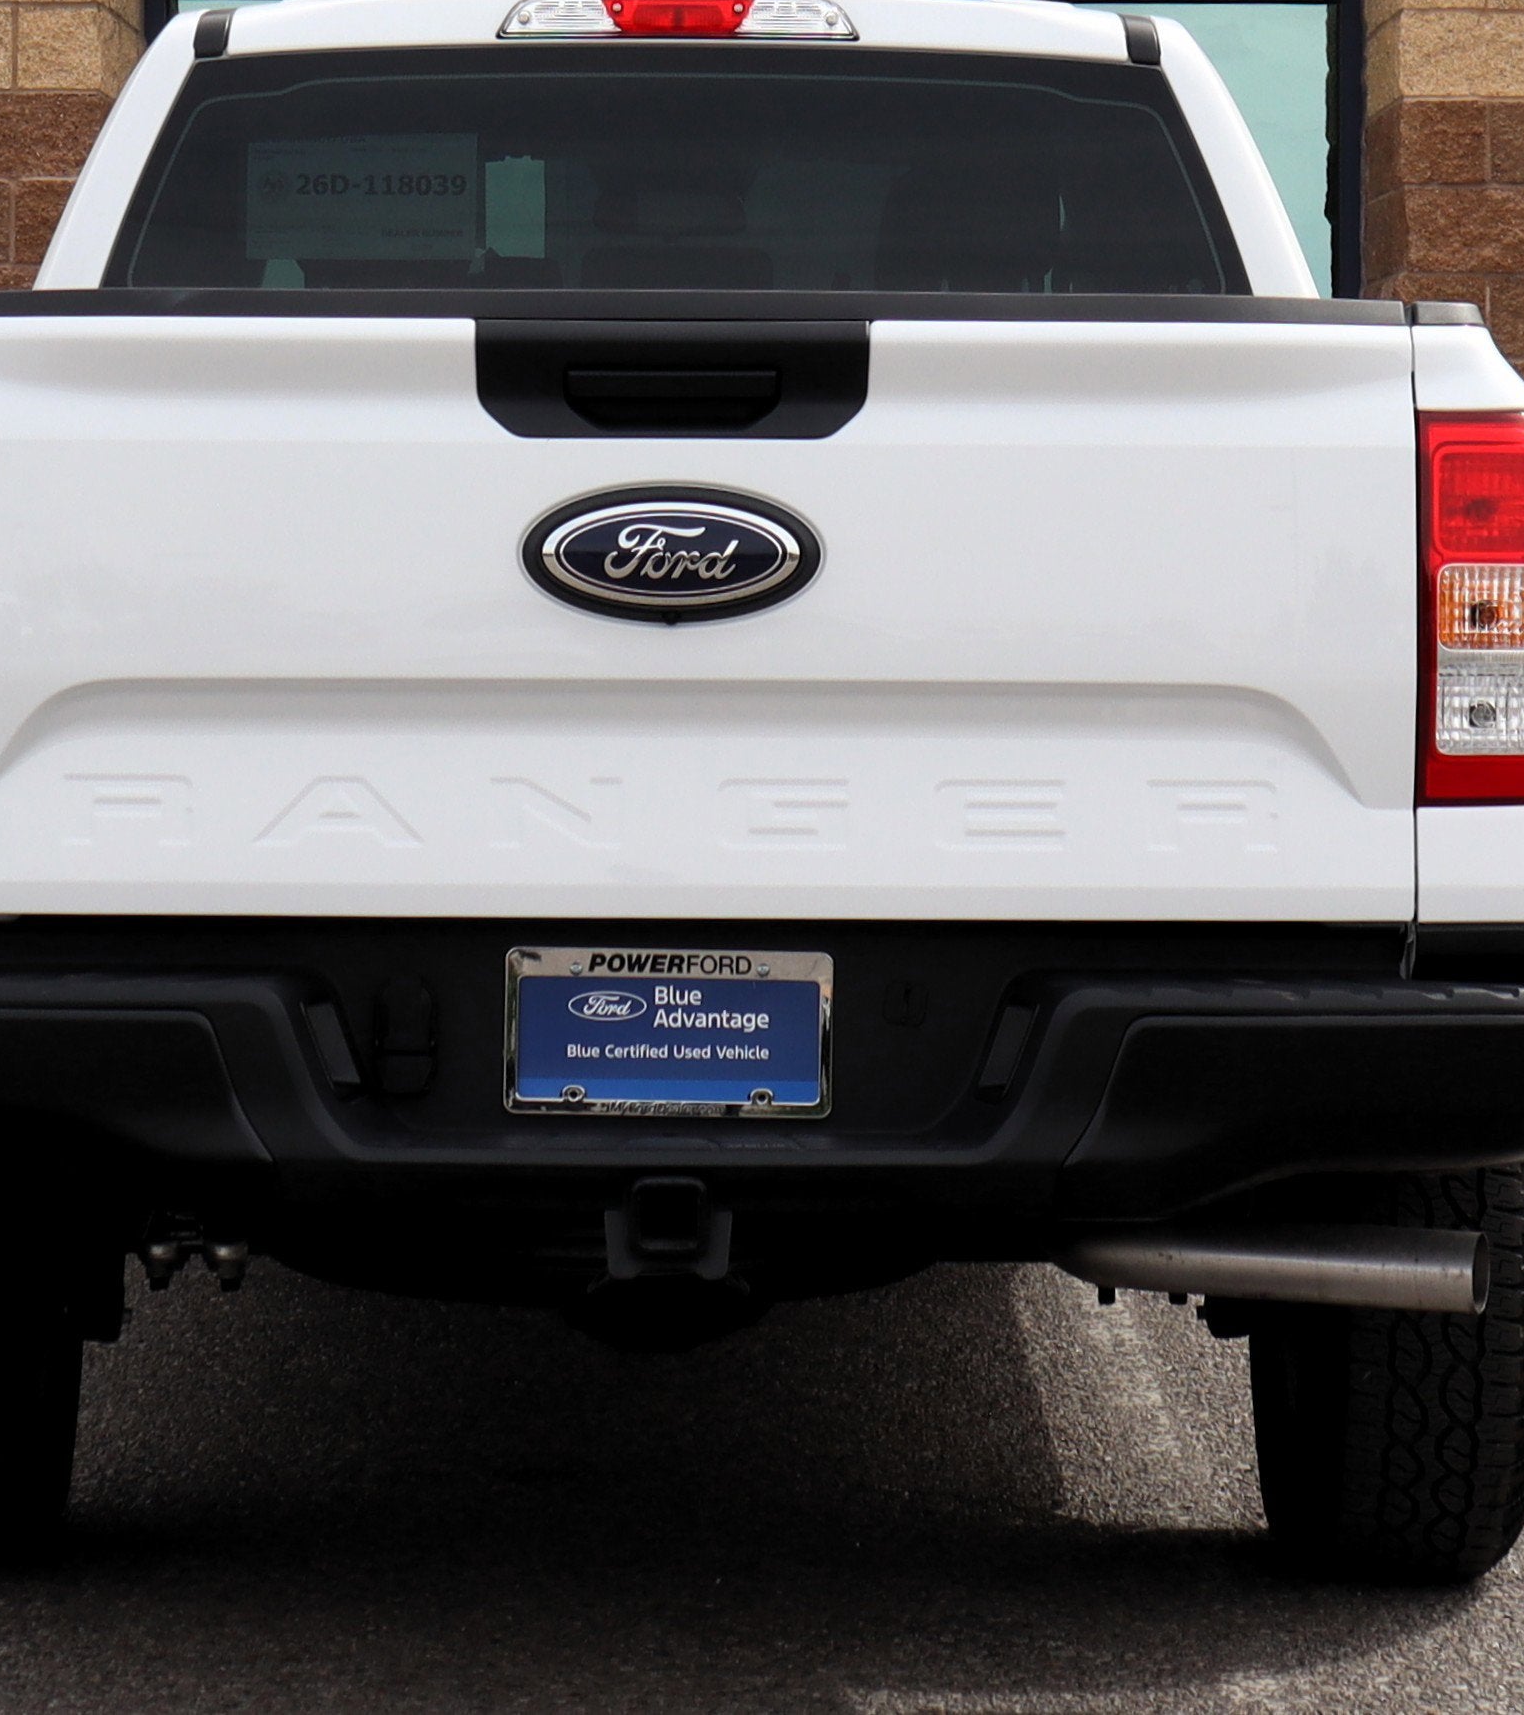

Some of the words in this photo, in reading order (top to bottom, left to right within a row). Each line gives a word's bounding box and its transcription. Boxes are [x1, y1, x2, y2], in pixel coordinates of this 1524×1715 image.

[296, 173, 467, 196] 26D-118039
[604, 523, 739, 580] Ford
[61, 772, 1280, 853] RANGER
[588, 952, 752, 976] POWERFORD
[583, 995, 632, 1017] Ford
[654, 985, 702, 1006] Blue
[653, 1008, 769, 1032] Advantage
[567, 1043, 600, 1059] Blue
[605, 1043, 668, 1060] Certified
[674, 1044, 711, 1060] Used
[716, 1045, 769, 1061] Vehicle
